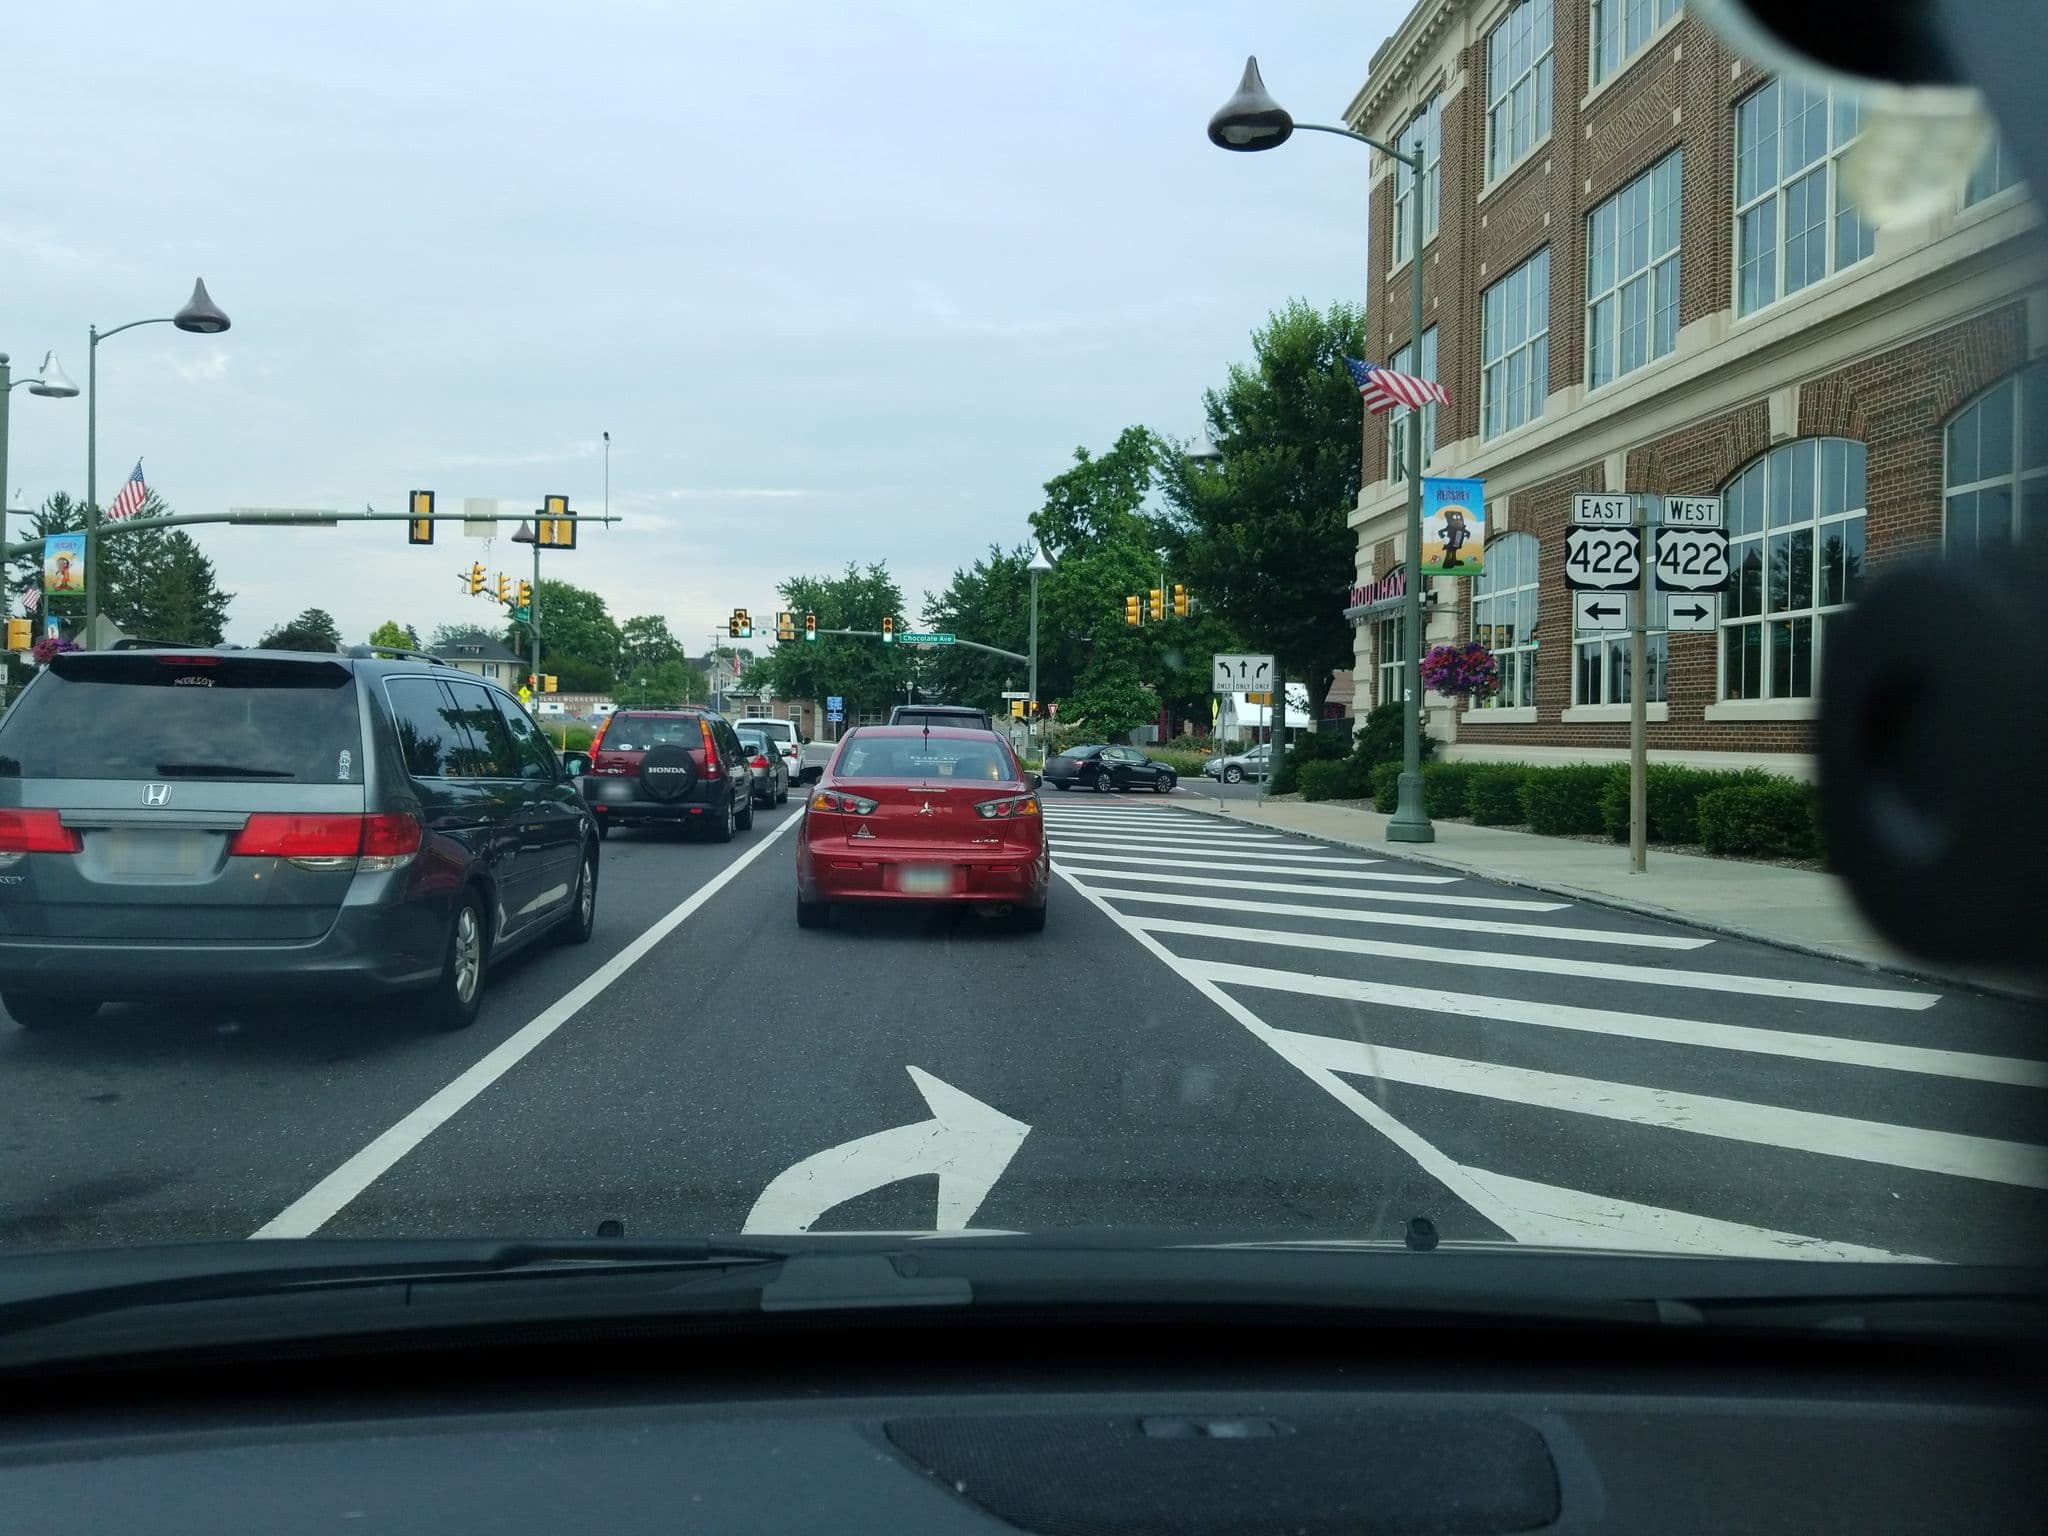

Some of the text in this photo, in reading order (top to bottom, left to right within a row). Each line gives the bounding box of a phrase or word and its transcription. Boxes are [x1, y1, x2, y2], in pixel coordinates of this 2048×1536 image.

[1581, 499, 1624, 519] EAST
[1670, 500, 1715, 521] WEST
[1570, 540, 1633, 573] 422
[1660, 542, 1722, 575] 422
